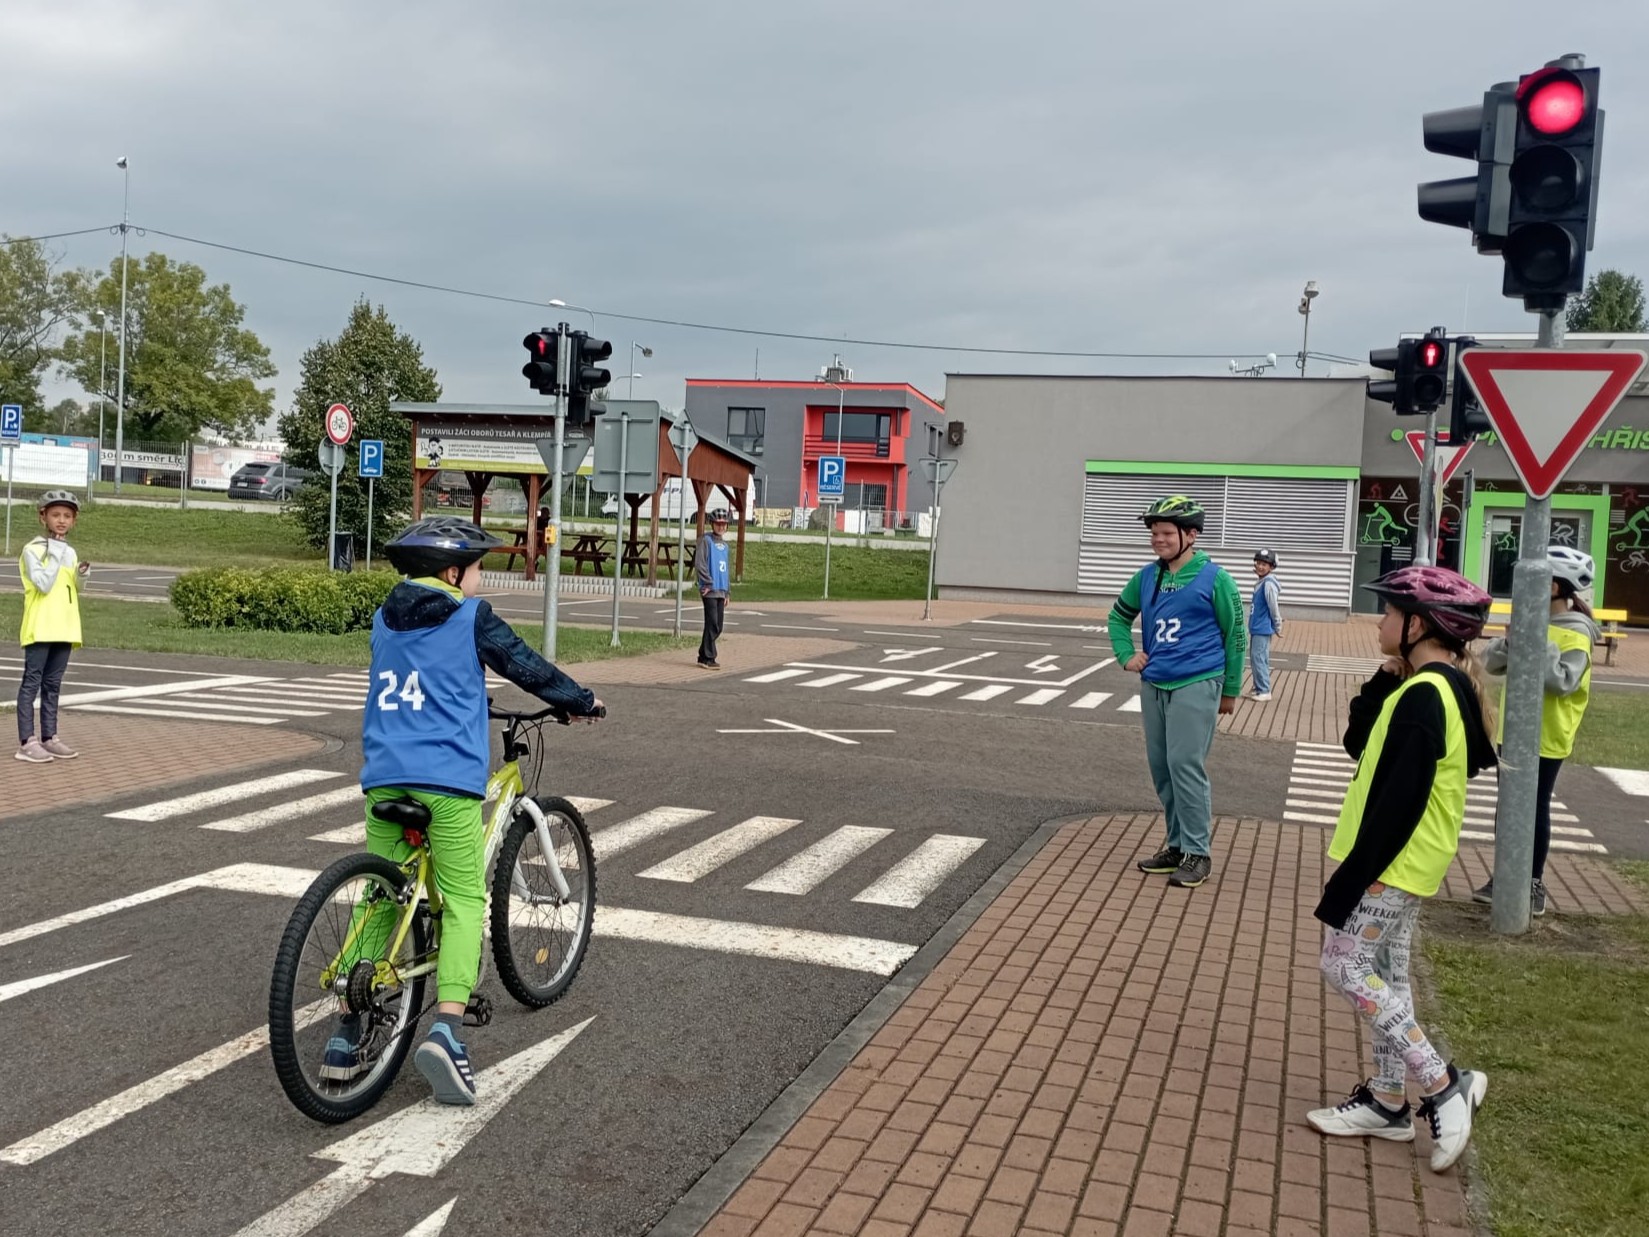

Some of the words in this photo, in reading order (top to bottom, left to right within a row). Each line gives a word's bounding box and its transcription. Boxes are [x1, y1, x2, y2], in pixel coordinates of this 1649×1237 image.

[5, 408, 17, 429] P
[421, 428, 454, 436] POSTAVILI
[495, 429, 516, 438] TESAŘ
[516, 430, 522, 438] A
[364, 444, 378, 466] P
[823, 460, 840, 484] P
[1155, 617, 1181, 643] 22
[378, 669, 425, 711] 24
